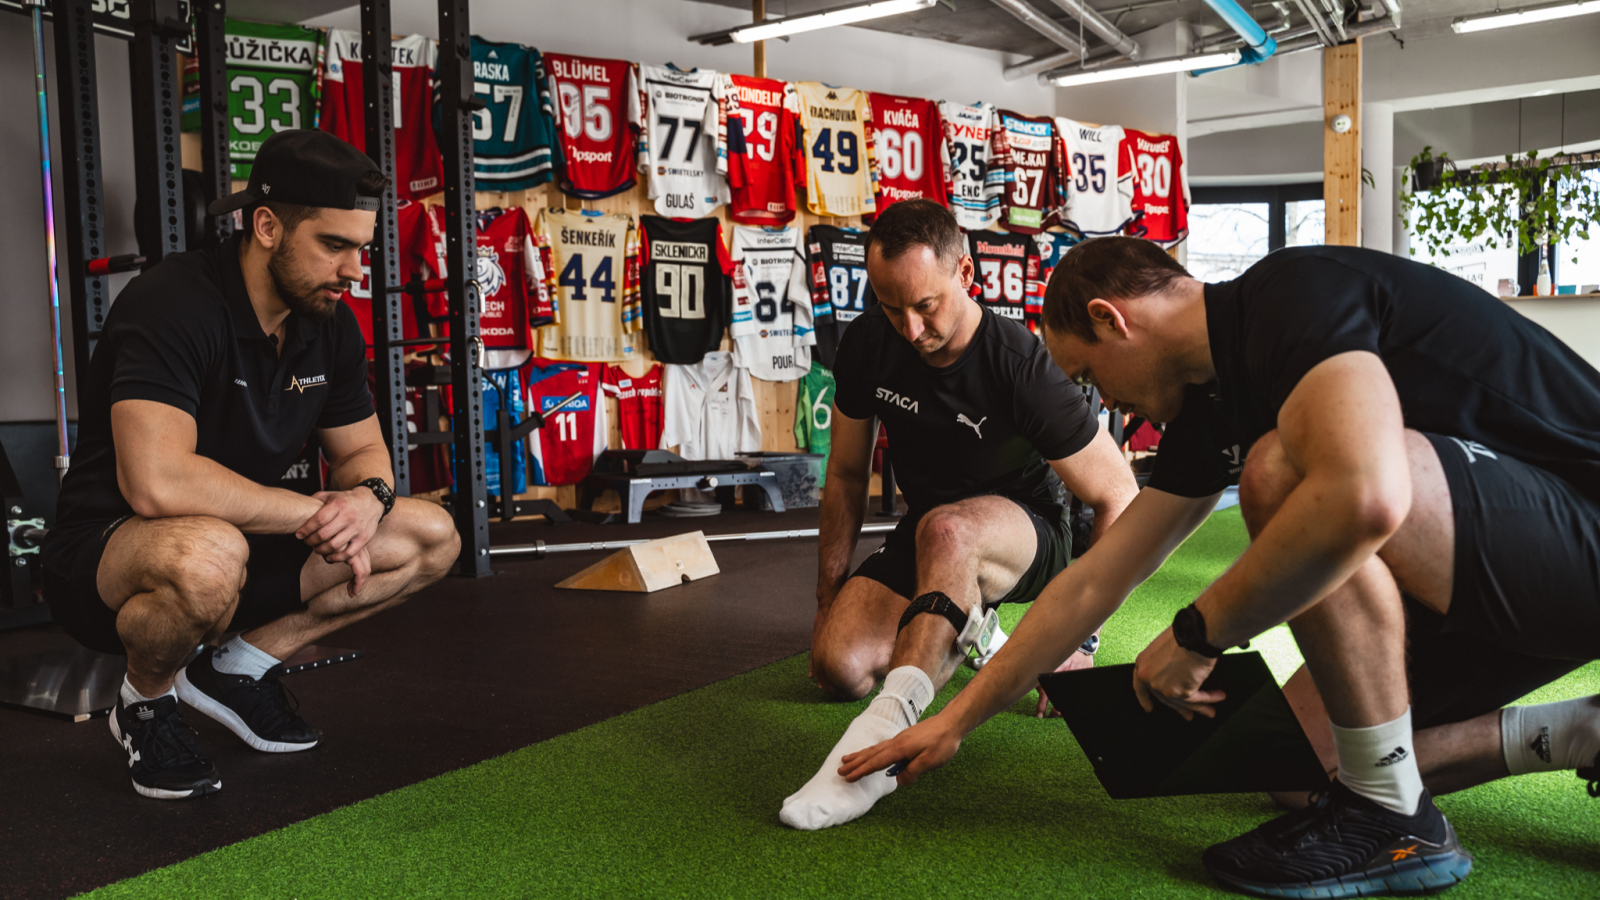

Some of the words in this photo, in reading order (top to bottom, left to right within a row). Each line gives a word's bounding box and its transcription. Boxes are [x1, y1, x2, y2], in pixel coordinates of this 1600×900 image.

[226, 36, 313, 66] ŮŽIČKA
[552, 60, 610, 83] BLÜMEL
[230, 75, 302, 135] 33
[471, 81, 523, 142] 57
[558, 81, 613, 142] 95
[883, 108, 919, 129] KVÁČA
[657, 114, 701, 164] 77
[812, 127, 860, 175] 49
[880, 127, 924, 182] 60
[952, 141, 985, 182] 25
[1012, 166, 1044, 208] 67
[1072, 152, 1106, 194] 35
[1137, 153, 1172, 198] 30
[665, 192, 695, 210] GULAŠ
[561, 225, 616, 248] ŠENKEŘÍK
[976, 240, 1025, 257] Mountfield
[558, 253, 616, 303] 44
[655, 263, 706, 320] 90
[829, 265, 868, 311] 87
[979, 257, 1024, 304] 36
[555, 412, 577, 442] 11
